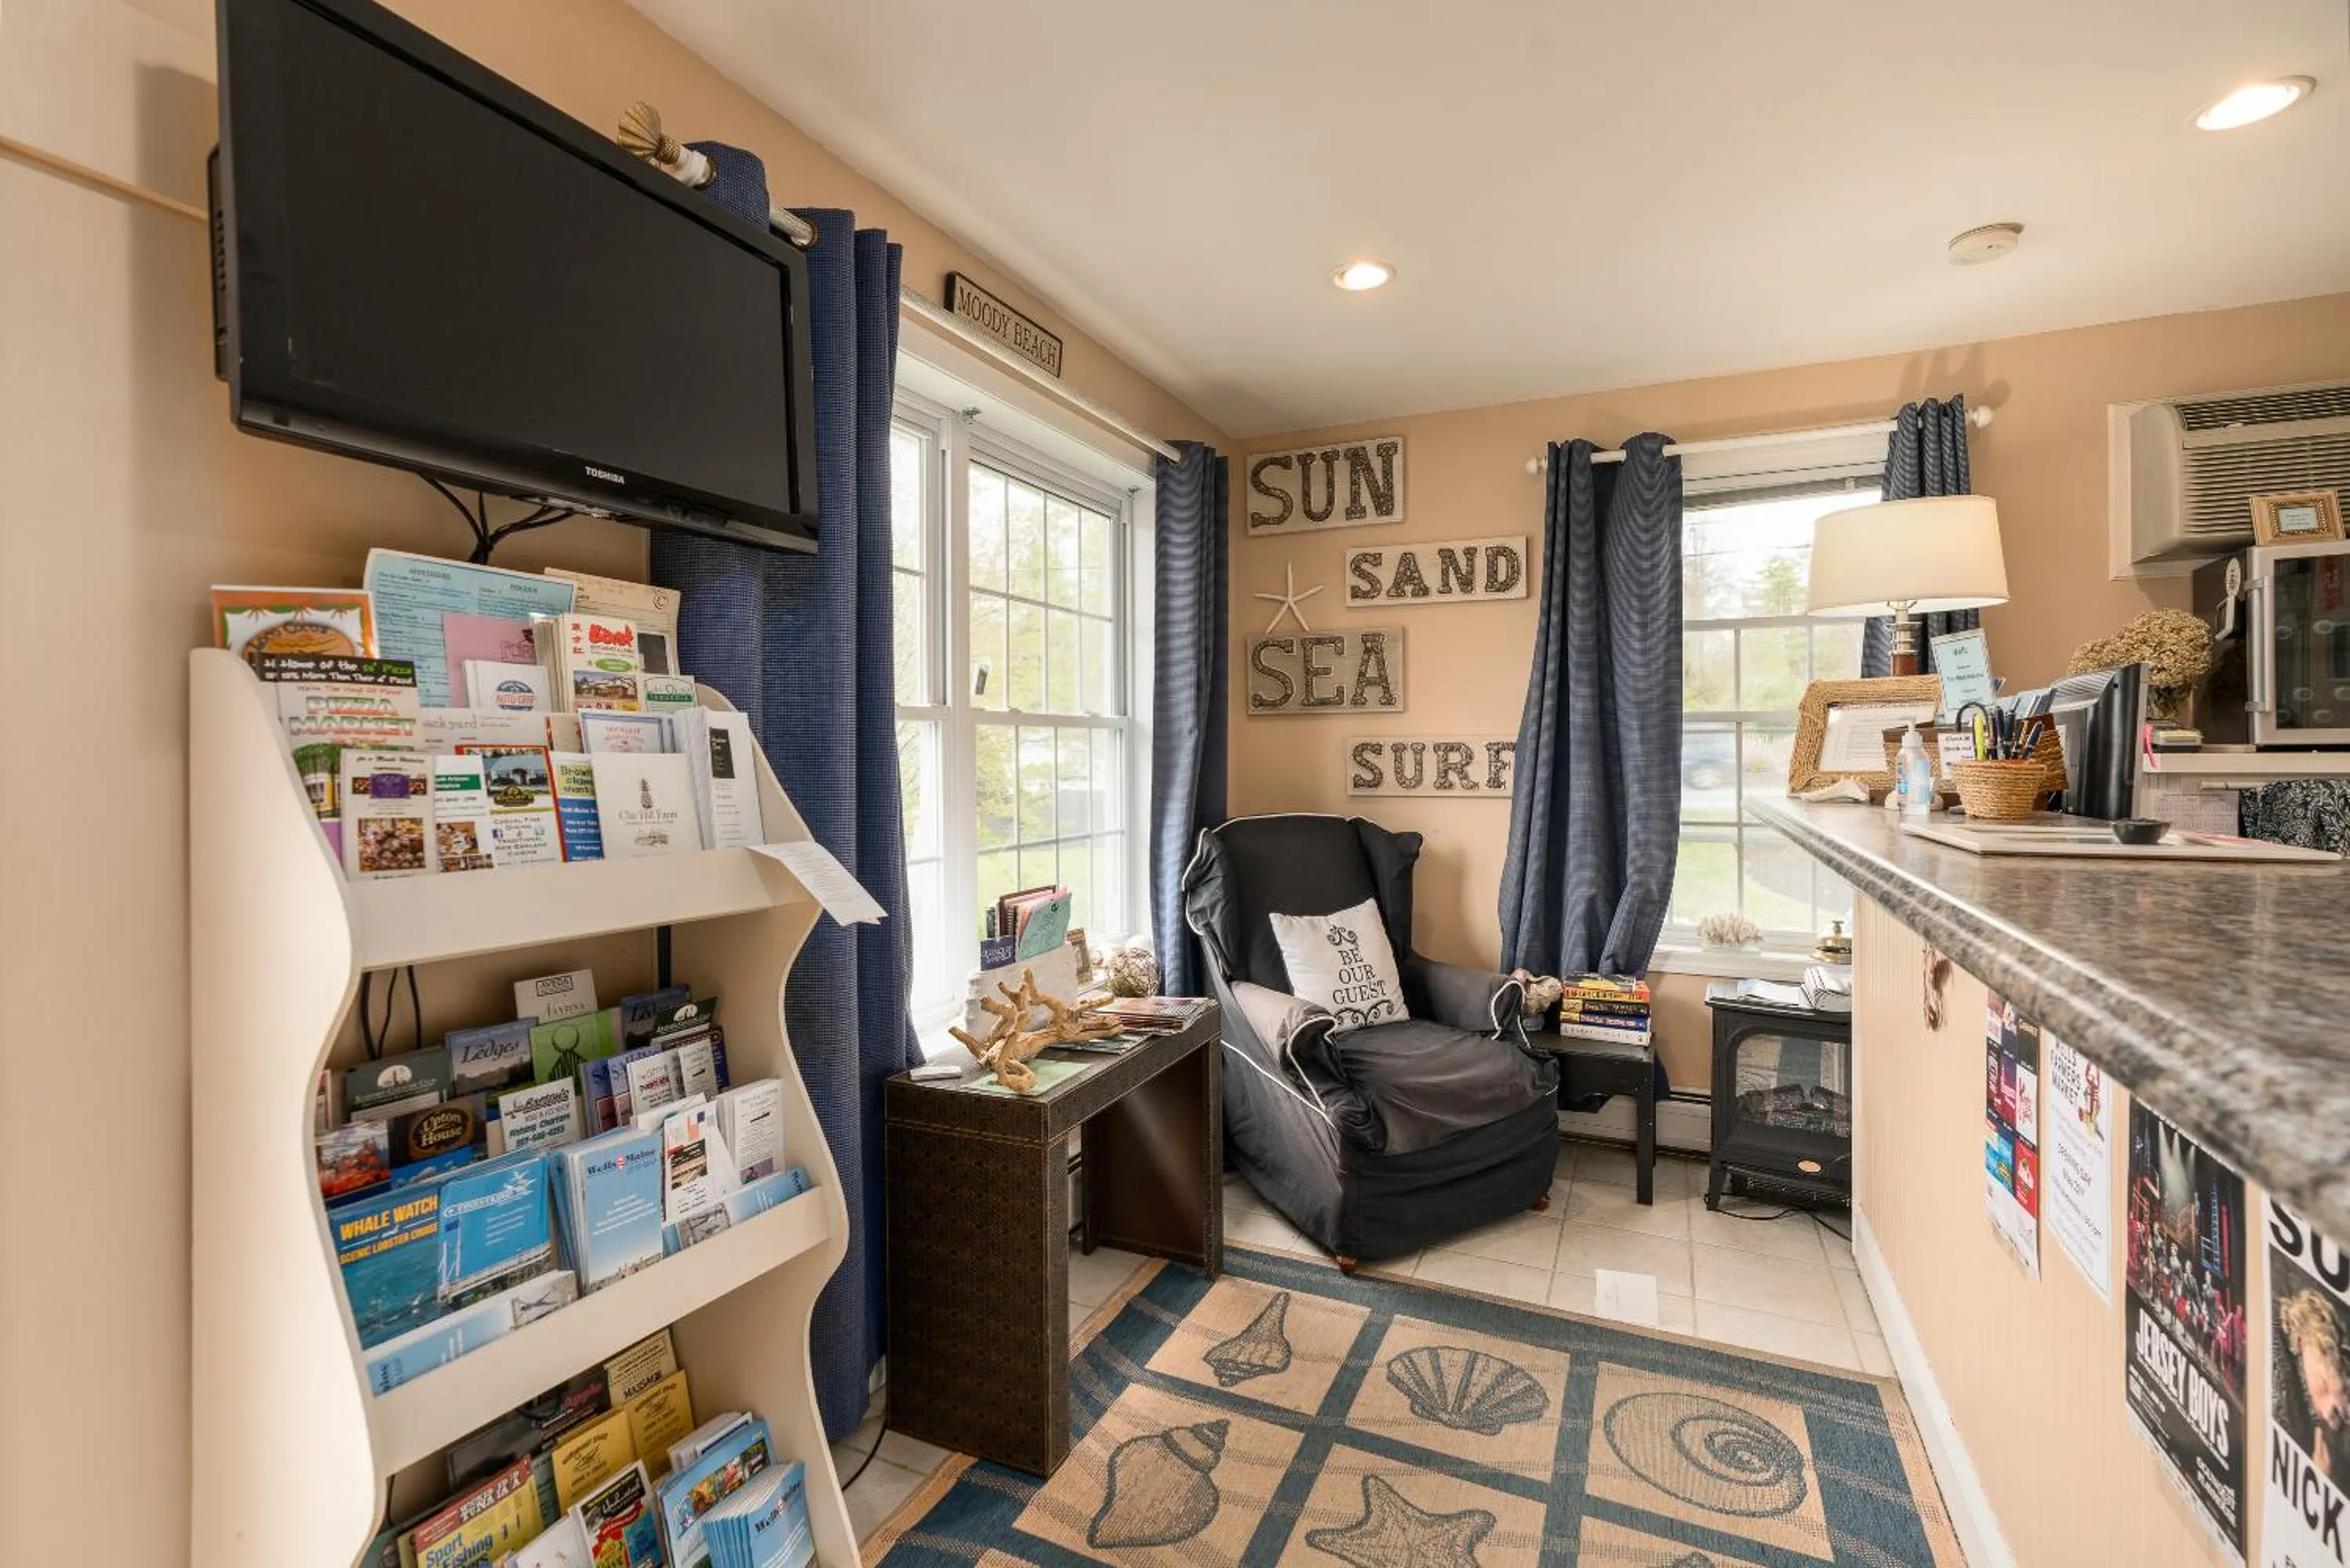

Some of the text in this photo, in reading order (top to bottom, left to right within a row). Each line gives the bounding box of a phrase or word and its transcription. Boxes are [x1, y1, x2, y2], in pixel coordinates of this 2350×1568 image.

[958, 285, 1057, 368] MOODY BEACH
[584, 465, 626, 485] TOSHIBA
[1250, 441, 1398, 528] SUN
[1349, 545, 1521, 601] SAND
[338, 661, 358, 672] the
[1251, 632, 1397, 710] SEA
[305, 695, 399, 717] PIZZA
[1351, 740, 1517, 791] SURF
[1338, 948, 1364, 966] BE
[1338, 964, 1376, 985] OUR
[1332, 980, 1387, 1005] GUEST
[420, 1126, 463, 1148] House
[586, 1147, 656, 1176] Wells Maine
[340, 1209, 390, 1242] WHALE
[393, 1193, 438, 1224] WATCH
[372, 1230, 410, 1254] LOBSTER
[2135, 1307, 2188, 1406] JERSEY
[2188, 1363, 2229, 1458] BOYS
[2272, 1428, 2345, 1566] NICK
[426, 1532, 463, 1568] Sport
[442, 1534, 493, 1568] Fishing
